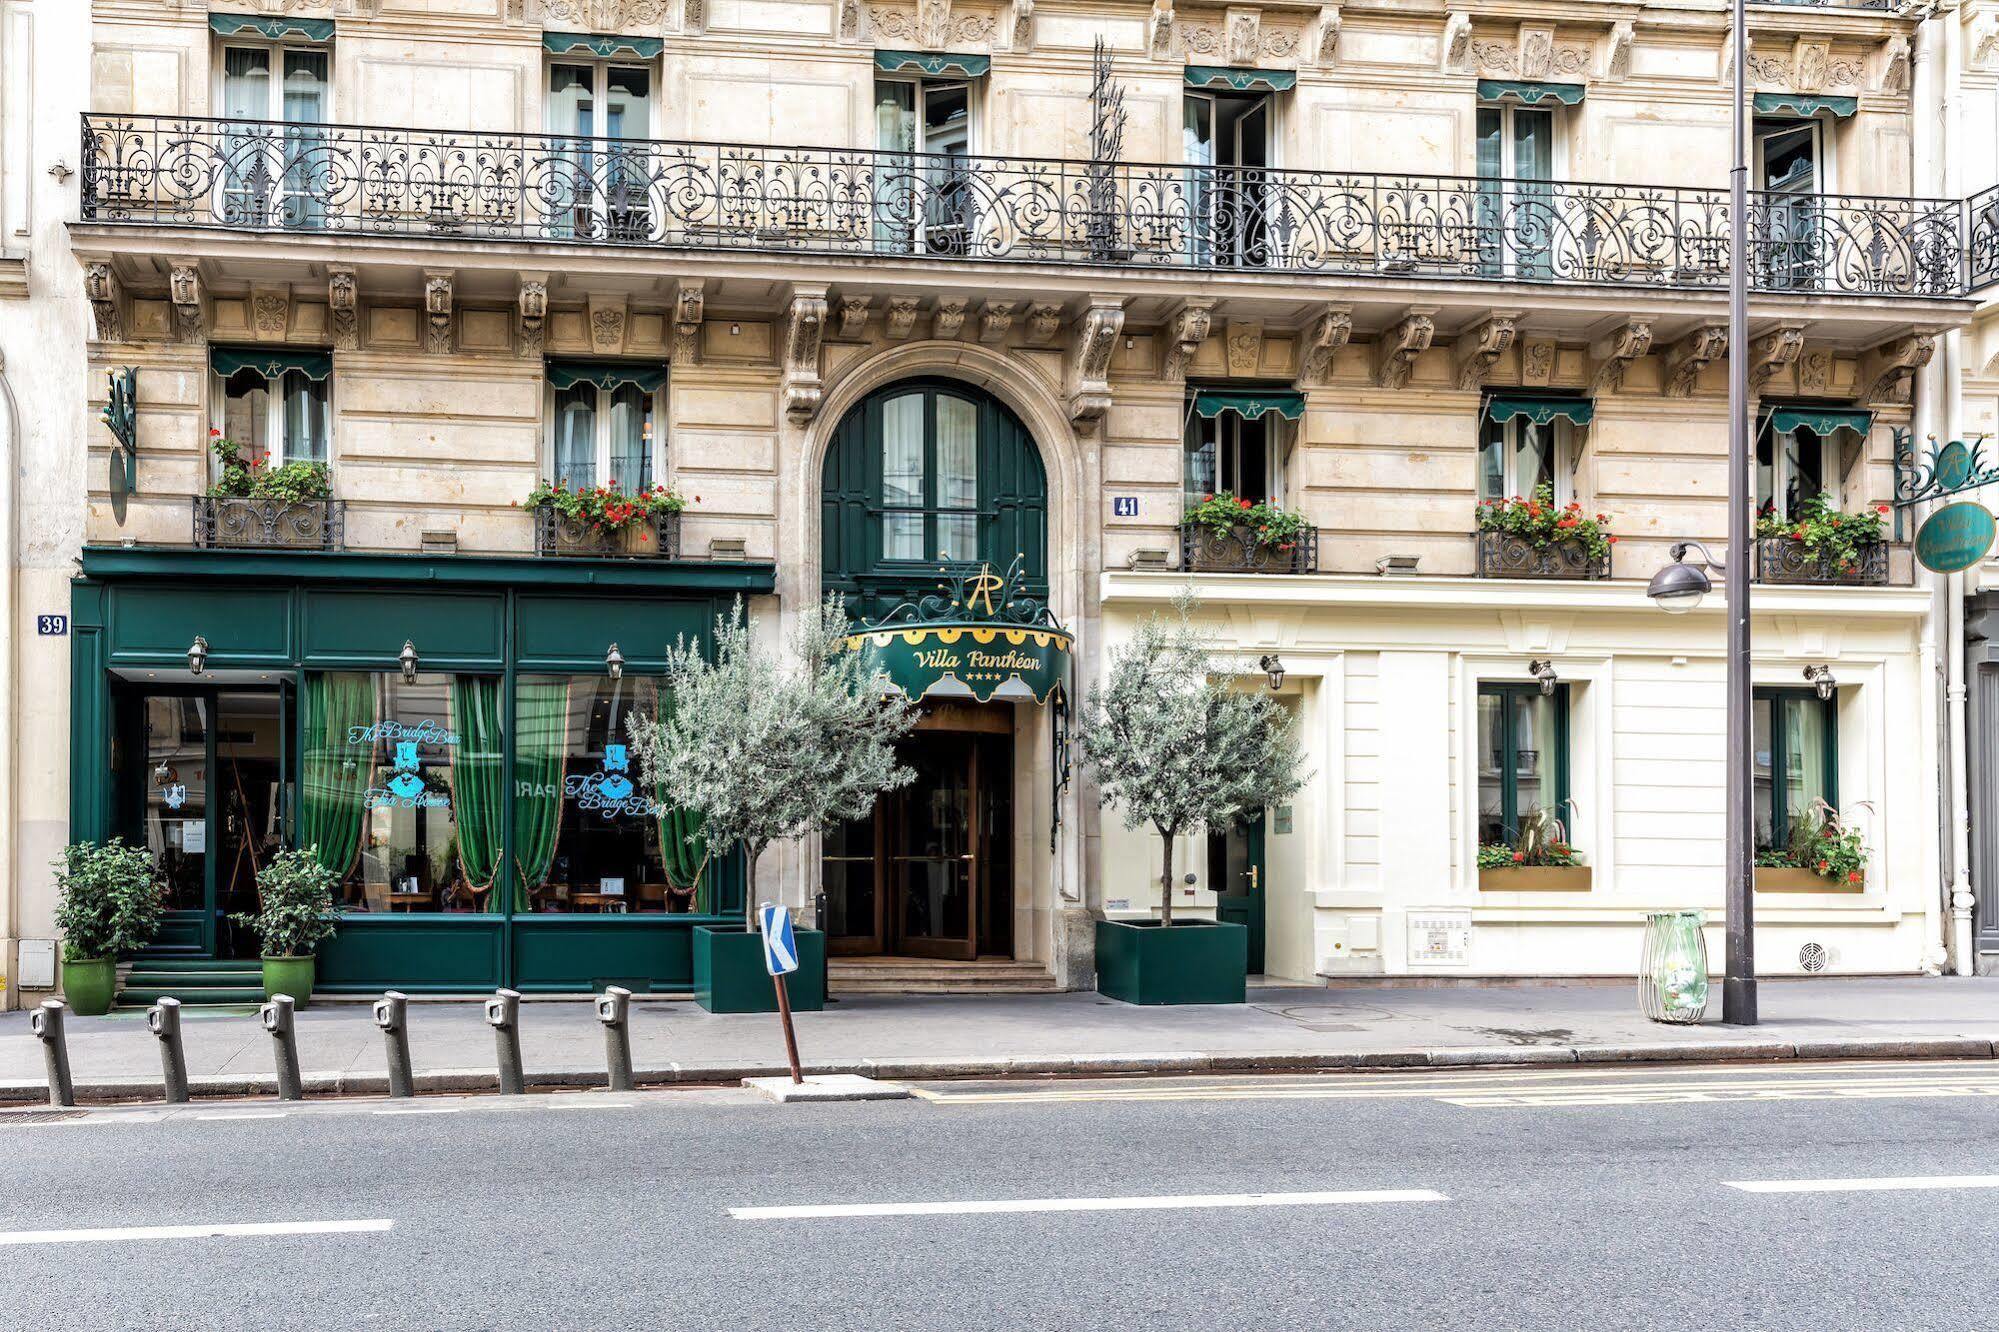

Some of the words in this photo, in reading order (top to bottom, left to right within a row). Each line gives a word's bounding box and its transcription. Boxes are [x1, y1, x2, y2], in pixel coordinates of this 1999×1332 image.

[1118, 498, 1135, 515] 41
[41, 616, 64, 633] 39
[913, 649, 962, 670] Villa
[966, 650, 1041, 671] Panthéon
[349, 724, 383, 744] The
[380, 719, 434, 743] Bridge
[565, 772, 604, 795] The
[364, 789, 397, 808] Tea
[402, 791, 450, 808] House
[578, 791, 628, 818] Bridge
